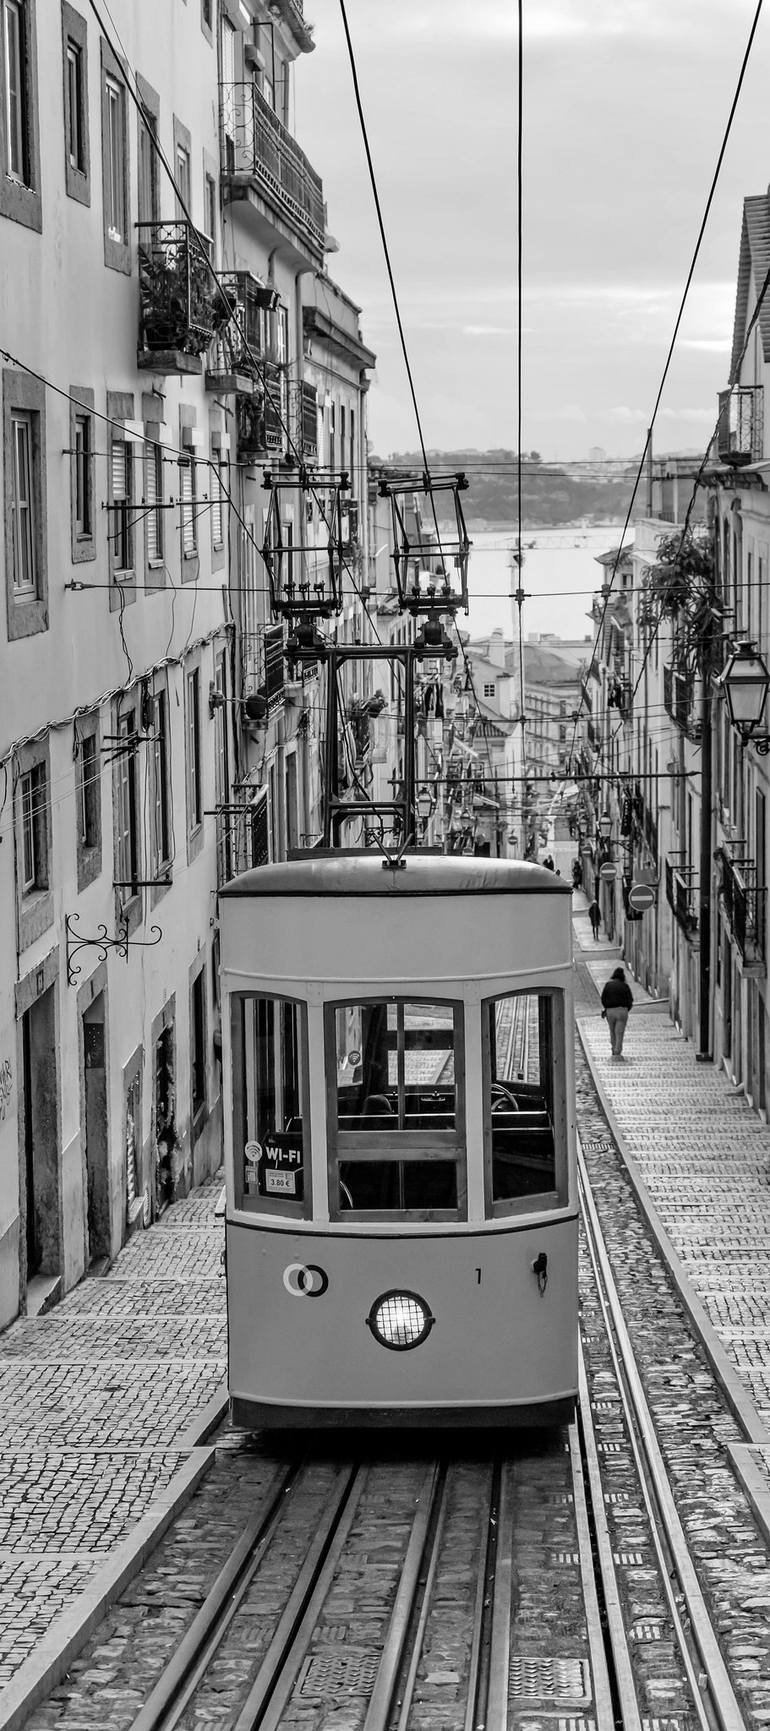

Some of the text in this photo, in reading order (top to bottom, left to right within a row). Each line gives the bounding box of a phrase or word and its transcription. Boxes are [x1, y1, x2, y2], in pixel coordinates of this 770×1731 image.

[265, 1146, 301, 1164] WI-FI
[285, 1180, 291, 1188] €
[475, 1267, 482, 1285] 1
